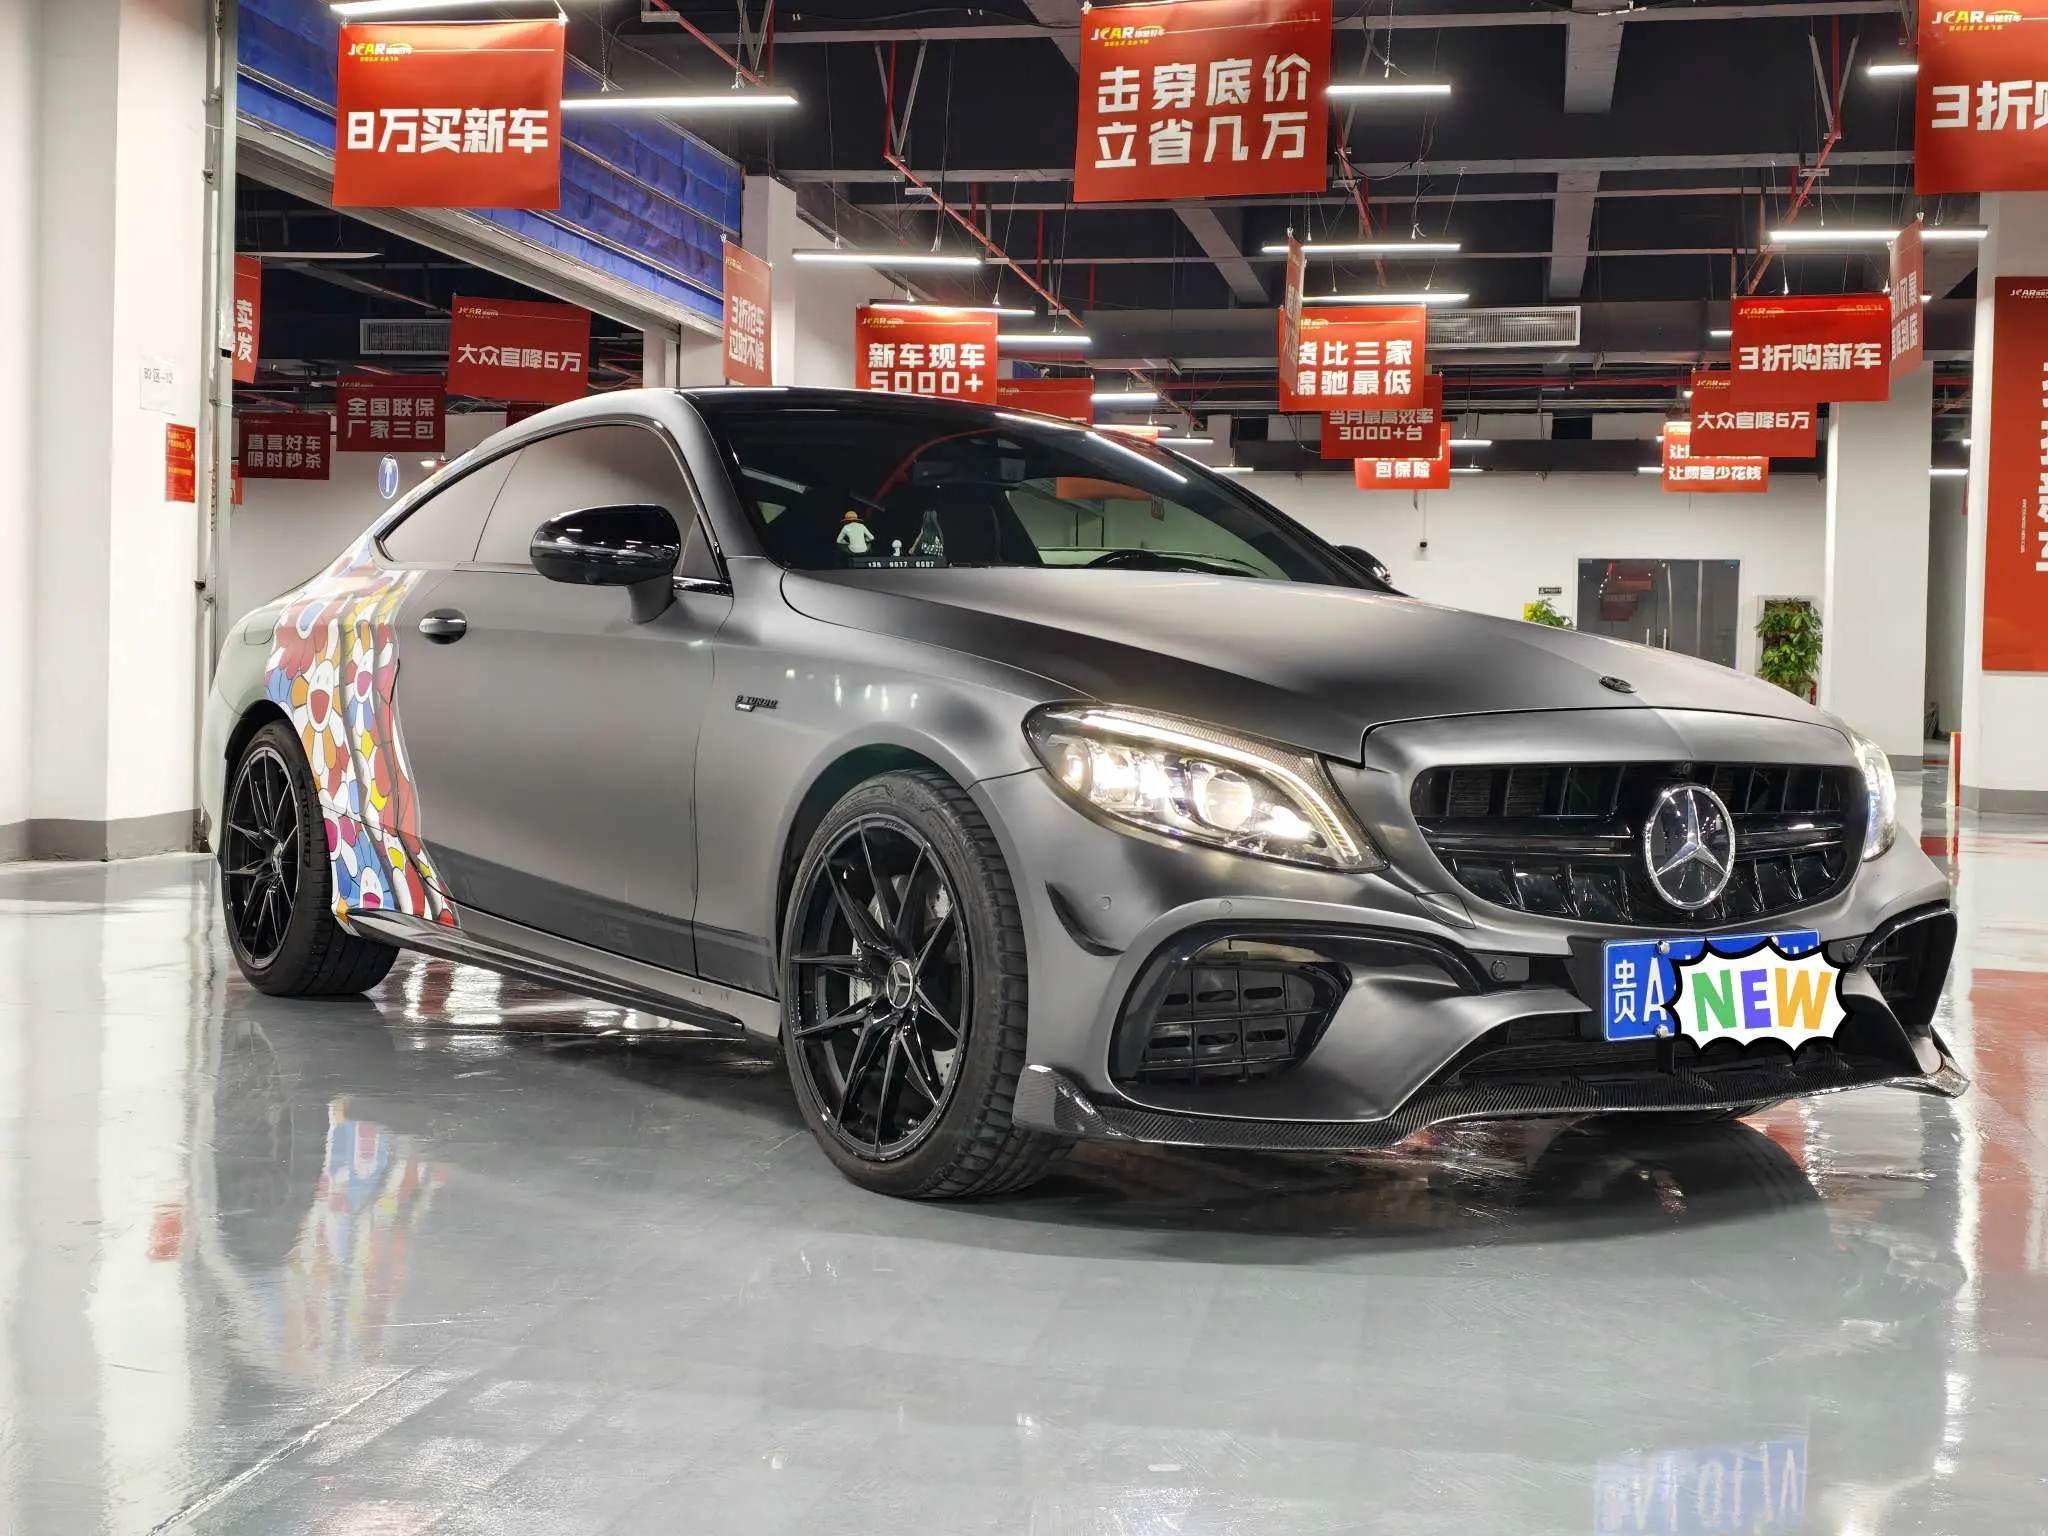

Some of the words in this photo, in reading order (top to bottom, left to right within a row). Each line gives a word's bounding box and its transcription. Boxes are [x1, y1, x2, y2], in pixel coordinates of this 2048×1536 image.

[1932, 11, 1985, 24] JCAR
[1091, 27, 1135, 40] JCAR
[348, 43, 386, 55] JCAR
[1098, 52, 1311, 113] 击穿底价
[347, 108, 549, 154] 8万买新车
[1094, 111, 1308, 169] 立省几万
[457, 307, 482, 315] JCAR
[1738, 307, 1766, 315] JCAR
[456, 343, 582, 373] 大众官降6万
[868, 343, 986, 369] 新车现车
[1298, 340, 1412, 366] 货比三家
[1739, 342, 1882, 372] 3折购新车
[870, 371, 984, 394] 5000+
[347, 396, 435, 417] 全国联保
[1329, 408, 1434, 425] 当月最高效率
[1697, 411, 1810, 430] 大众官降6万
[347, 420, 435, 439] 厂家三包
[1339, 425, 1422, 441] 3000+台
[247, 451, 321, 469] 限时秒杀
[1376, 461, 1430, 478] 包保险
[1669, 465, 1762, 481] 让顾客少花钱
